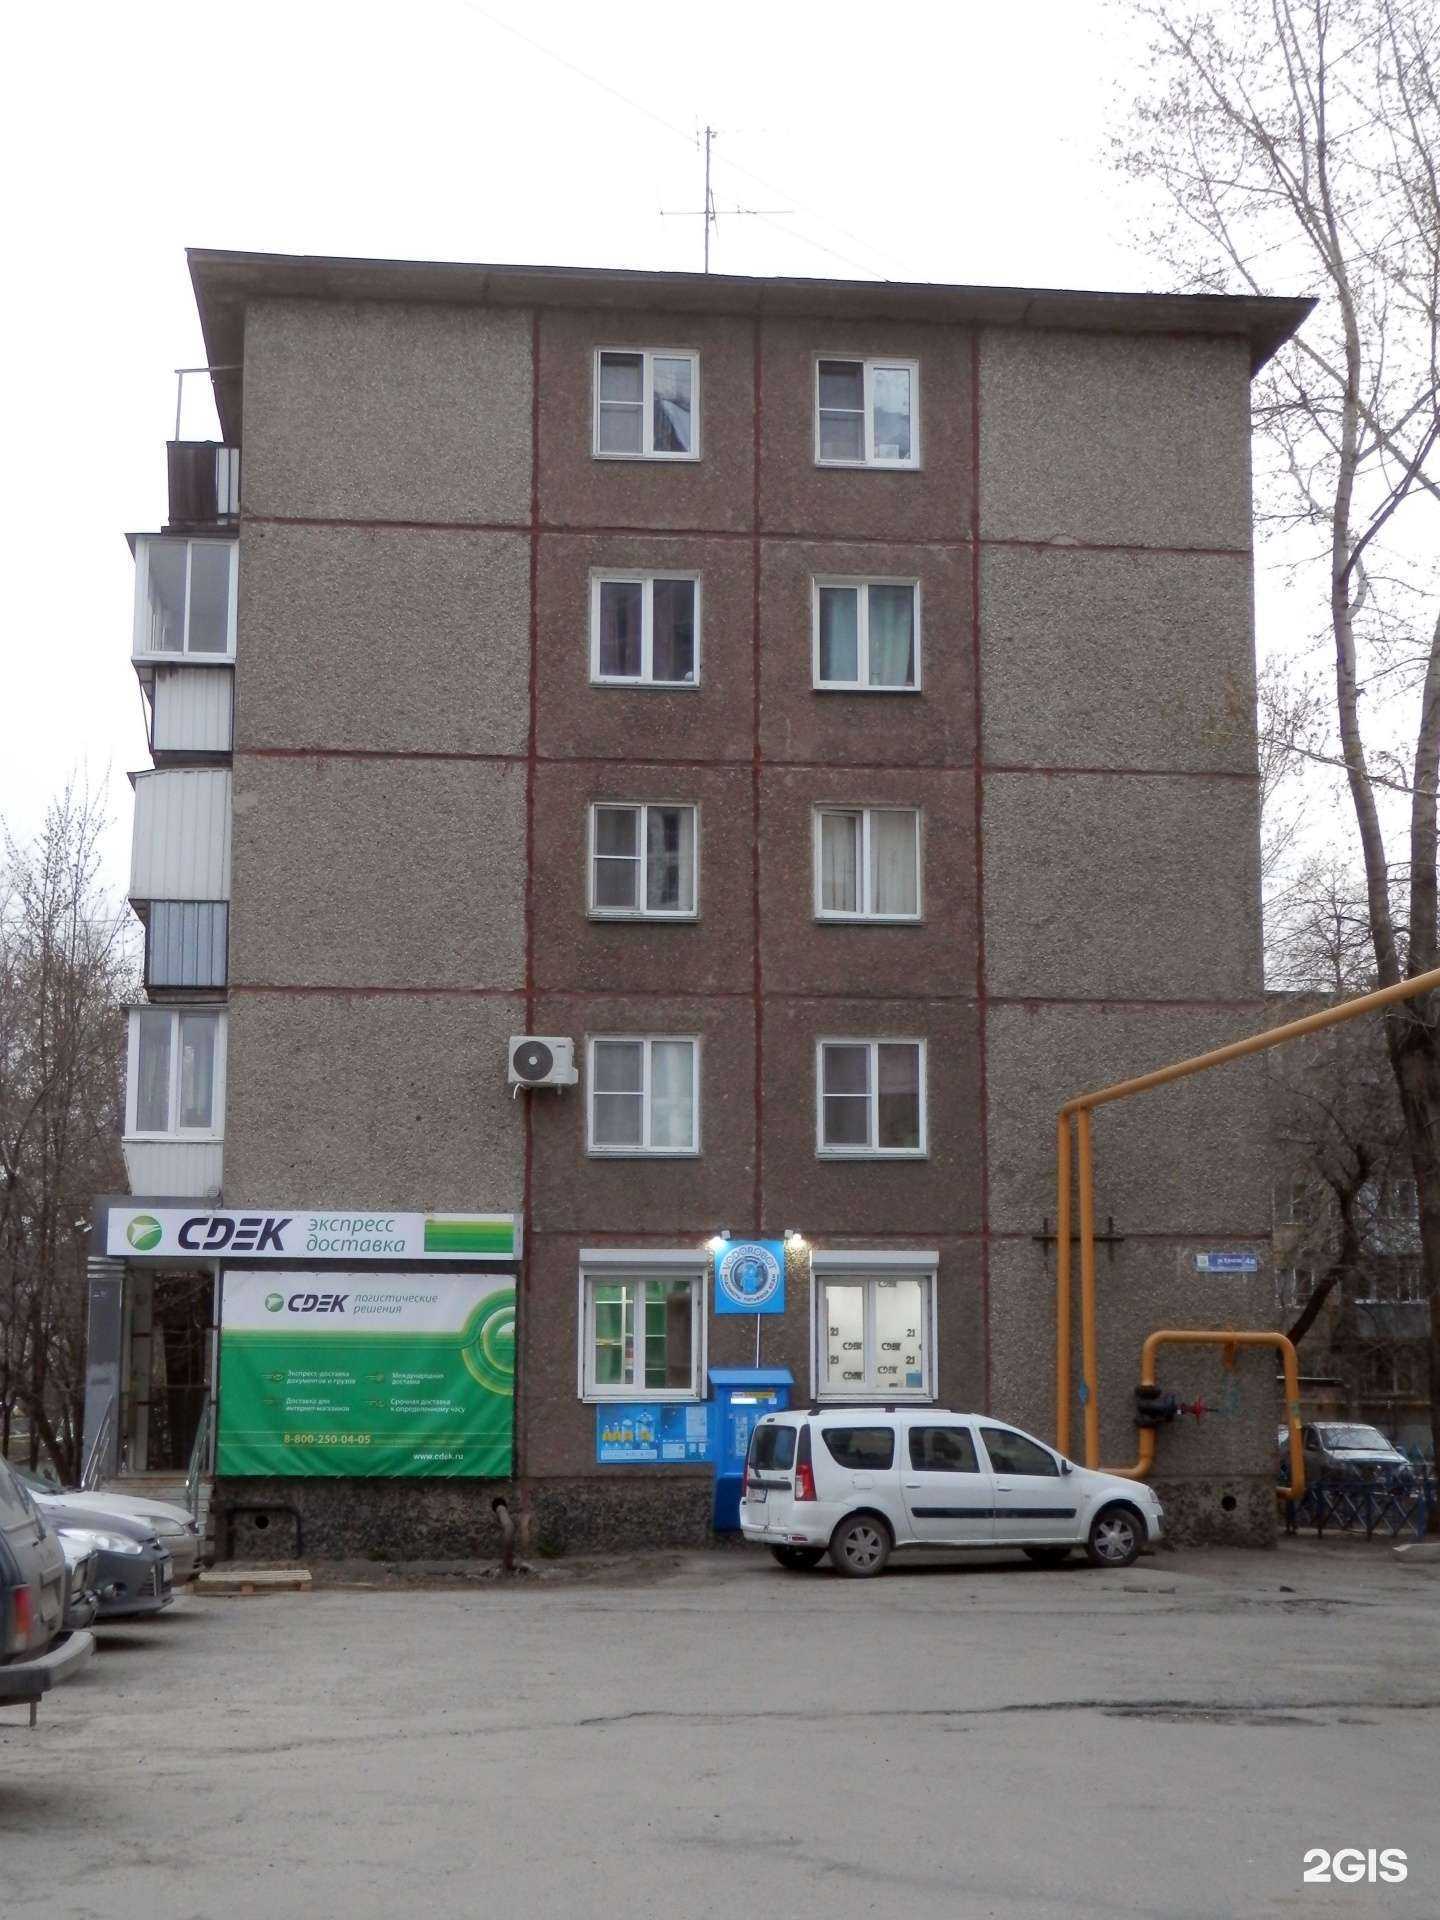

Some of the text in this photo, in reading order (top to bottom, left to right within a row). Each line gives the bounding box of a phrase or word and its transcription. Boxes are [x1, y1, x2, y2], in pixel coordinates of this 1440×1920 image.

[177, 1217, 293, 1251] CDEK
[308, 1218, 395, 1236] экспресс
[306, 1233, 406, 1252] доставка
[287, 1293, 350, 1313] CDEK
[353, 1304, 402, 1315] решения
[284, 1434, 371, 1445] 8-800-250-04-05
[413, 1451, 464, 1461] www.cdek.ru
